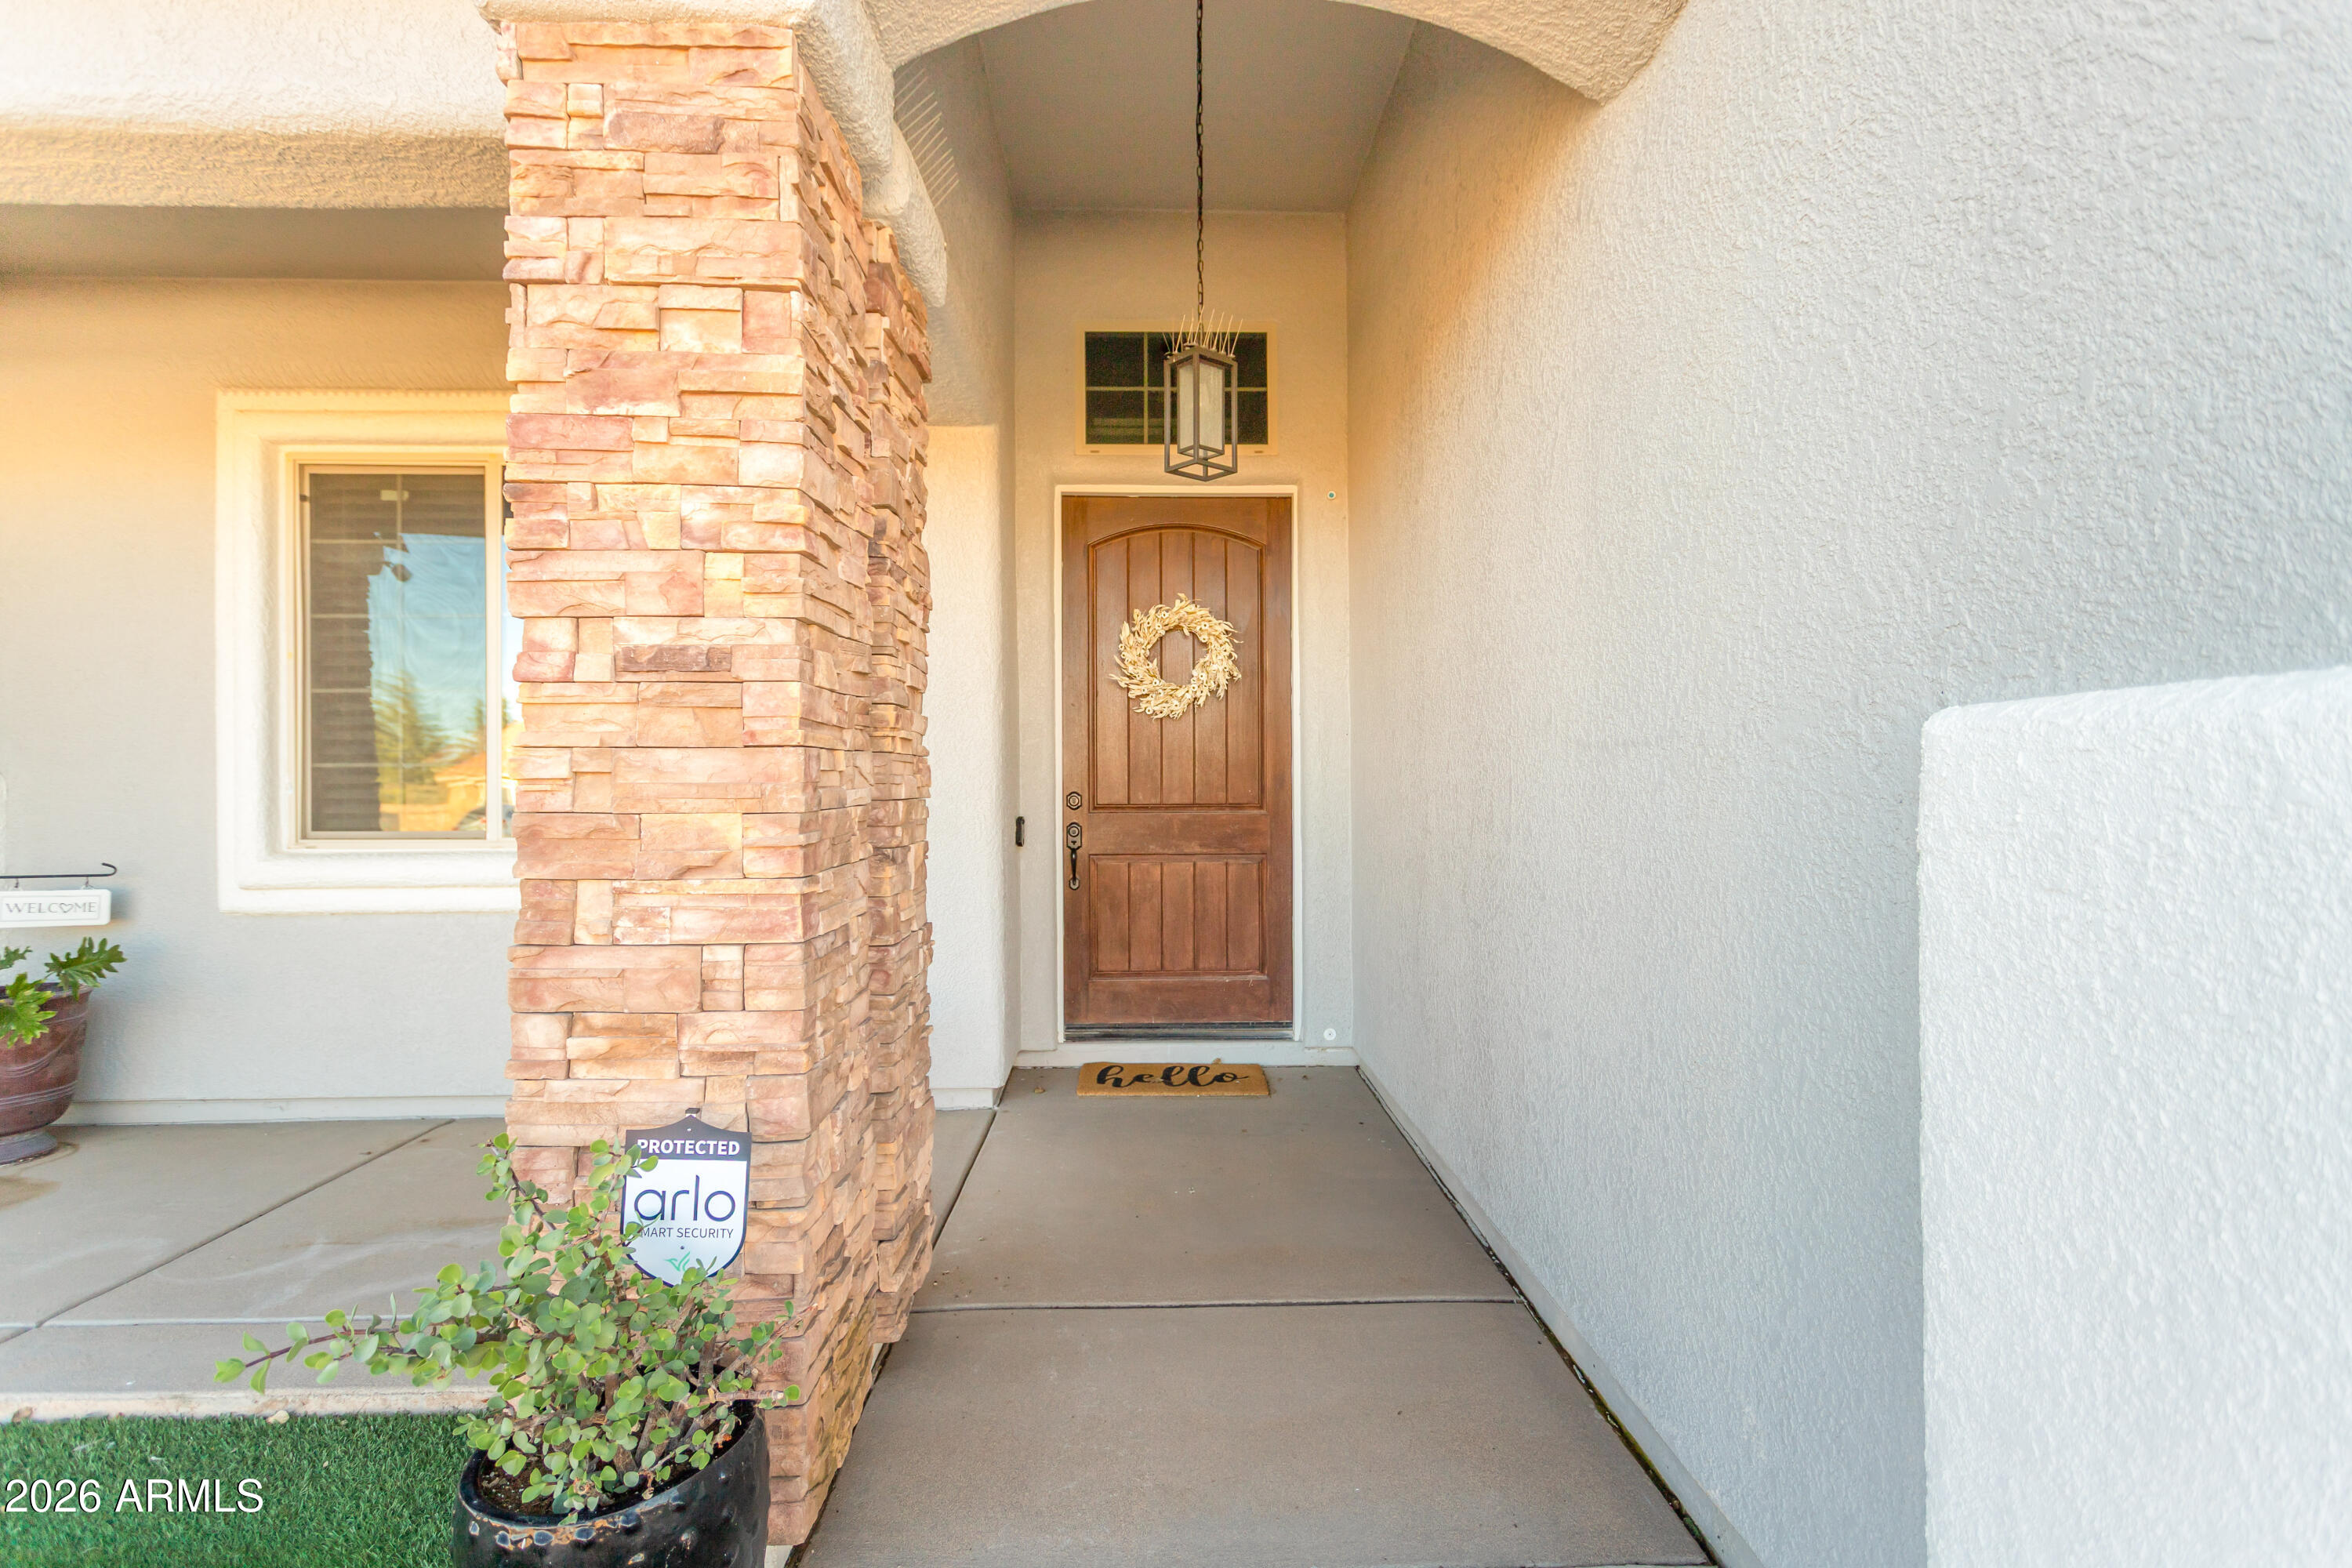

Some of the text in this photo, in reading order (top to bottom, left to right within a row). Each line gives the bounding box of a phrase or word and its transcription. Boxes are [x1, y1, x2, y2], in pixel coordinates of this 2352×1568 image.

[1096, 1065, 1249, 1088] hello
[637, 1138, 741, 1156] PROTECTED
[633, 1174, 736, 1222] arlo
[639, 1227, 734, 1239] MART SECURITY
